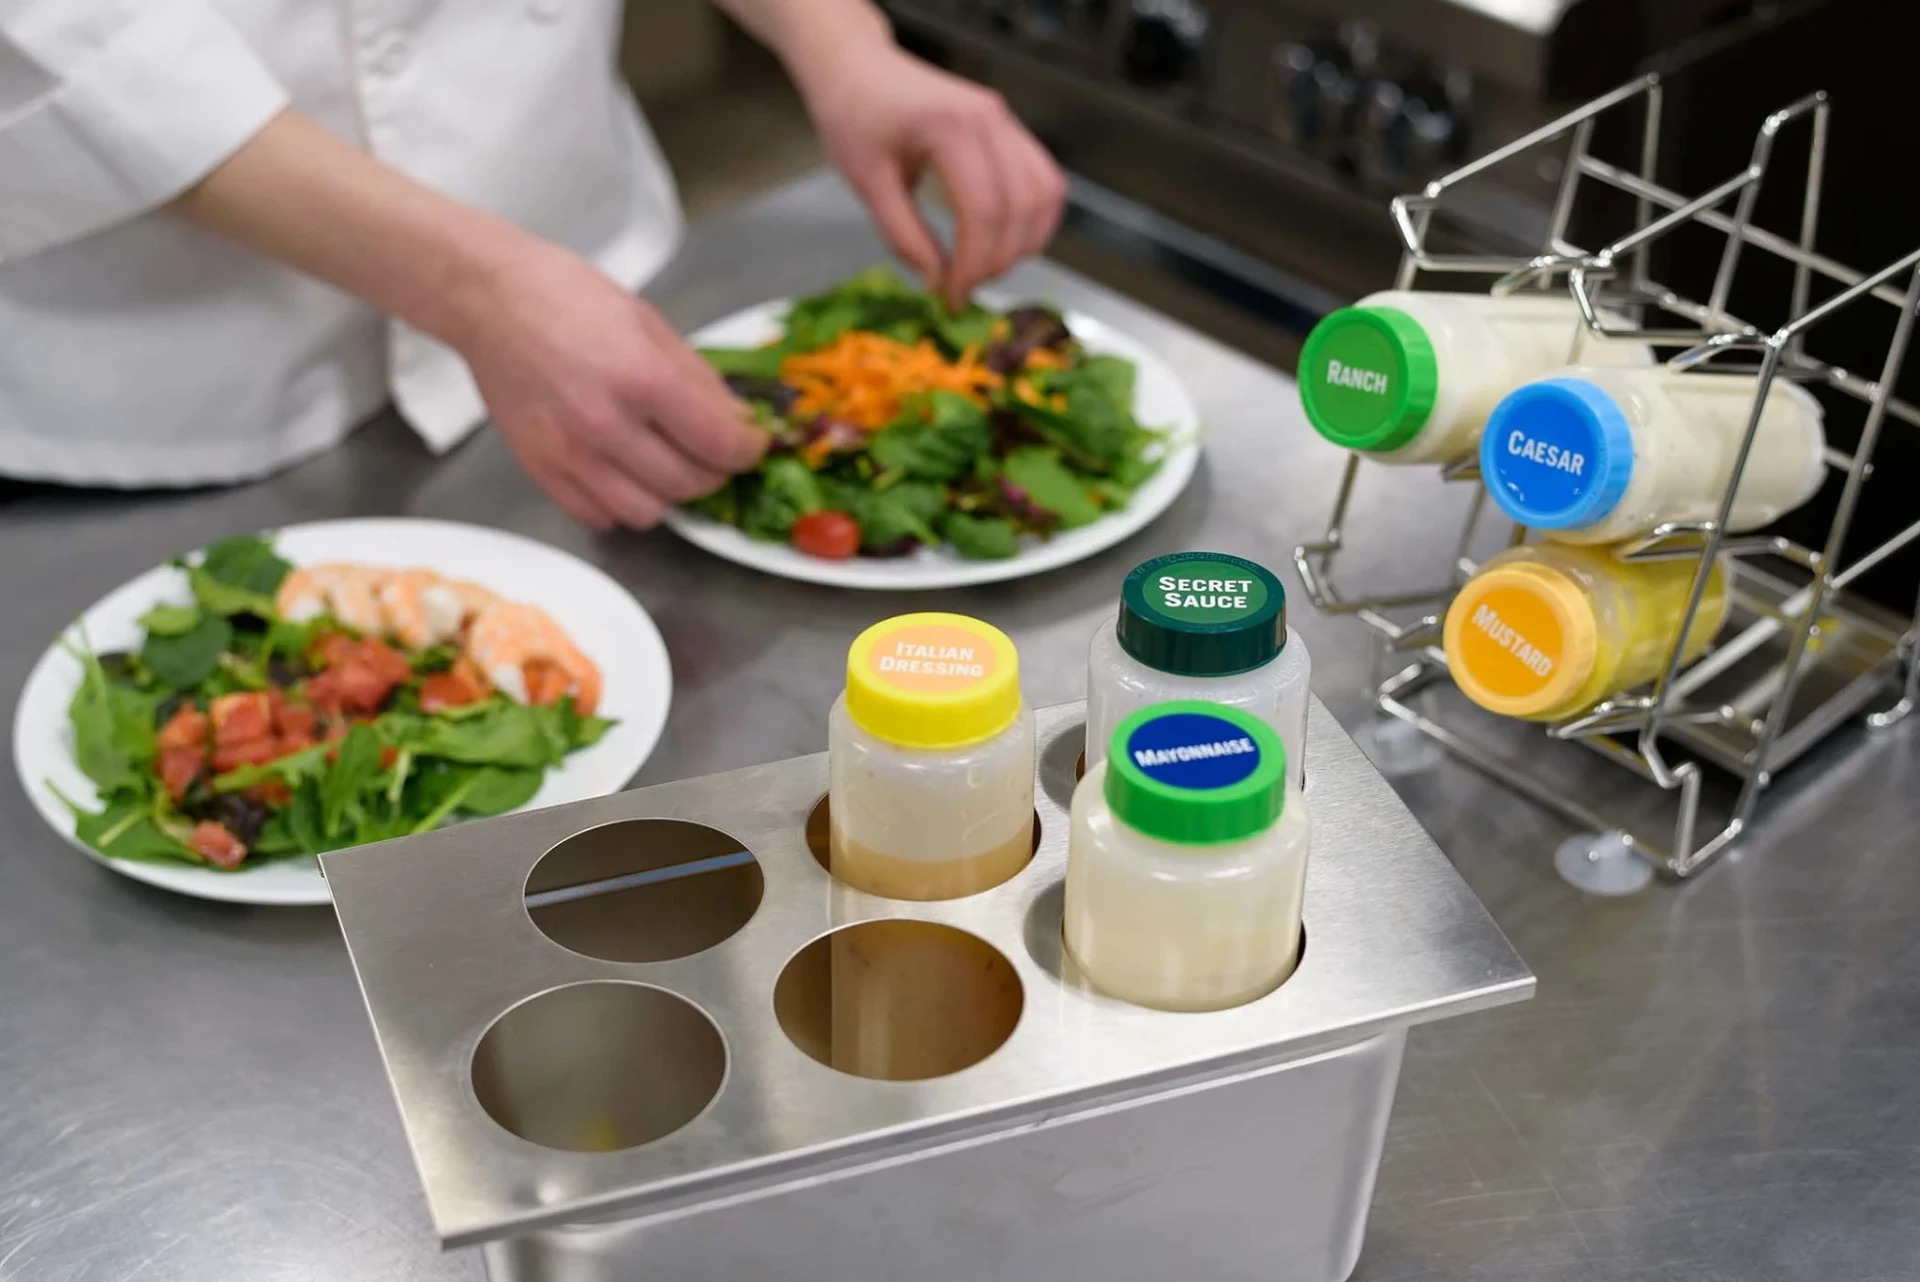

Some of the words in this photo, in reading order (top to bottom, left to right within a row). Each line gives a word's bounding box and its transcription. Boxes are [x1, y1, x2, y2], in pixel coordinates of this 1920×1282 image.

[1326, 359, 1388, 395] RANCH
[1507, 430, 1585, 476] CAESAR
[1158, 576, 1252, 593] SECRET
[1164, 592, 1248, 609] SAUCE
[895, 641, 974, 661] ITALIAN
[1472, 603, 1553, 677] MUSTARD
[879, 655, 984, 678] DRESSING
[1134, 737, 1255, 767] MAYONNAISE
